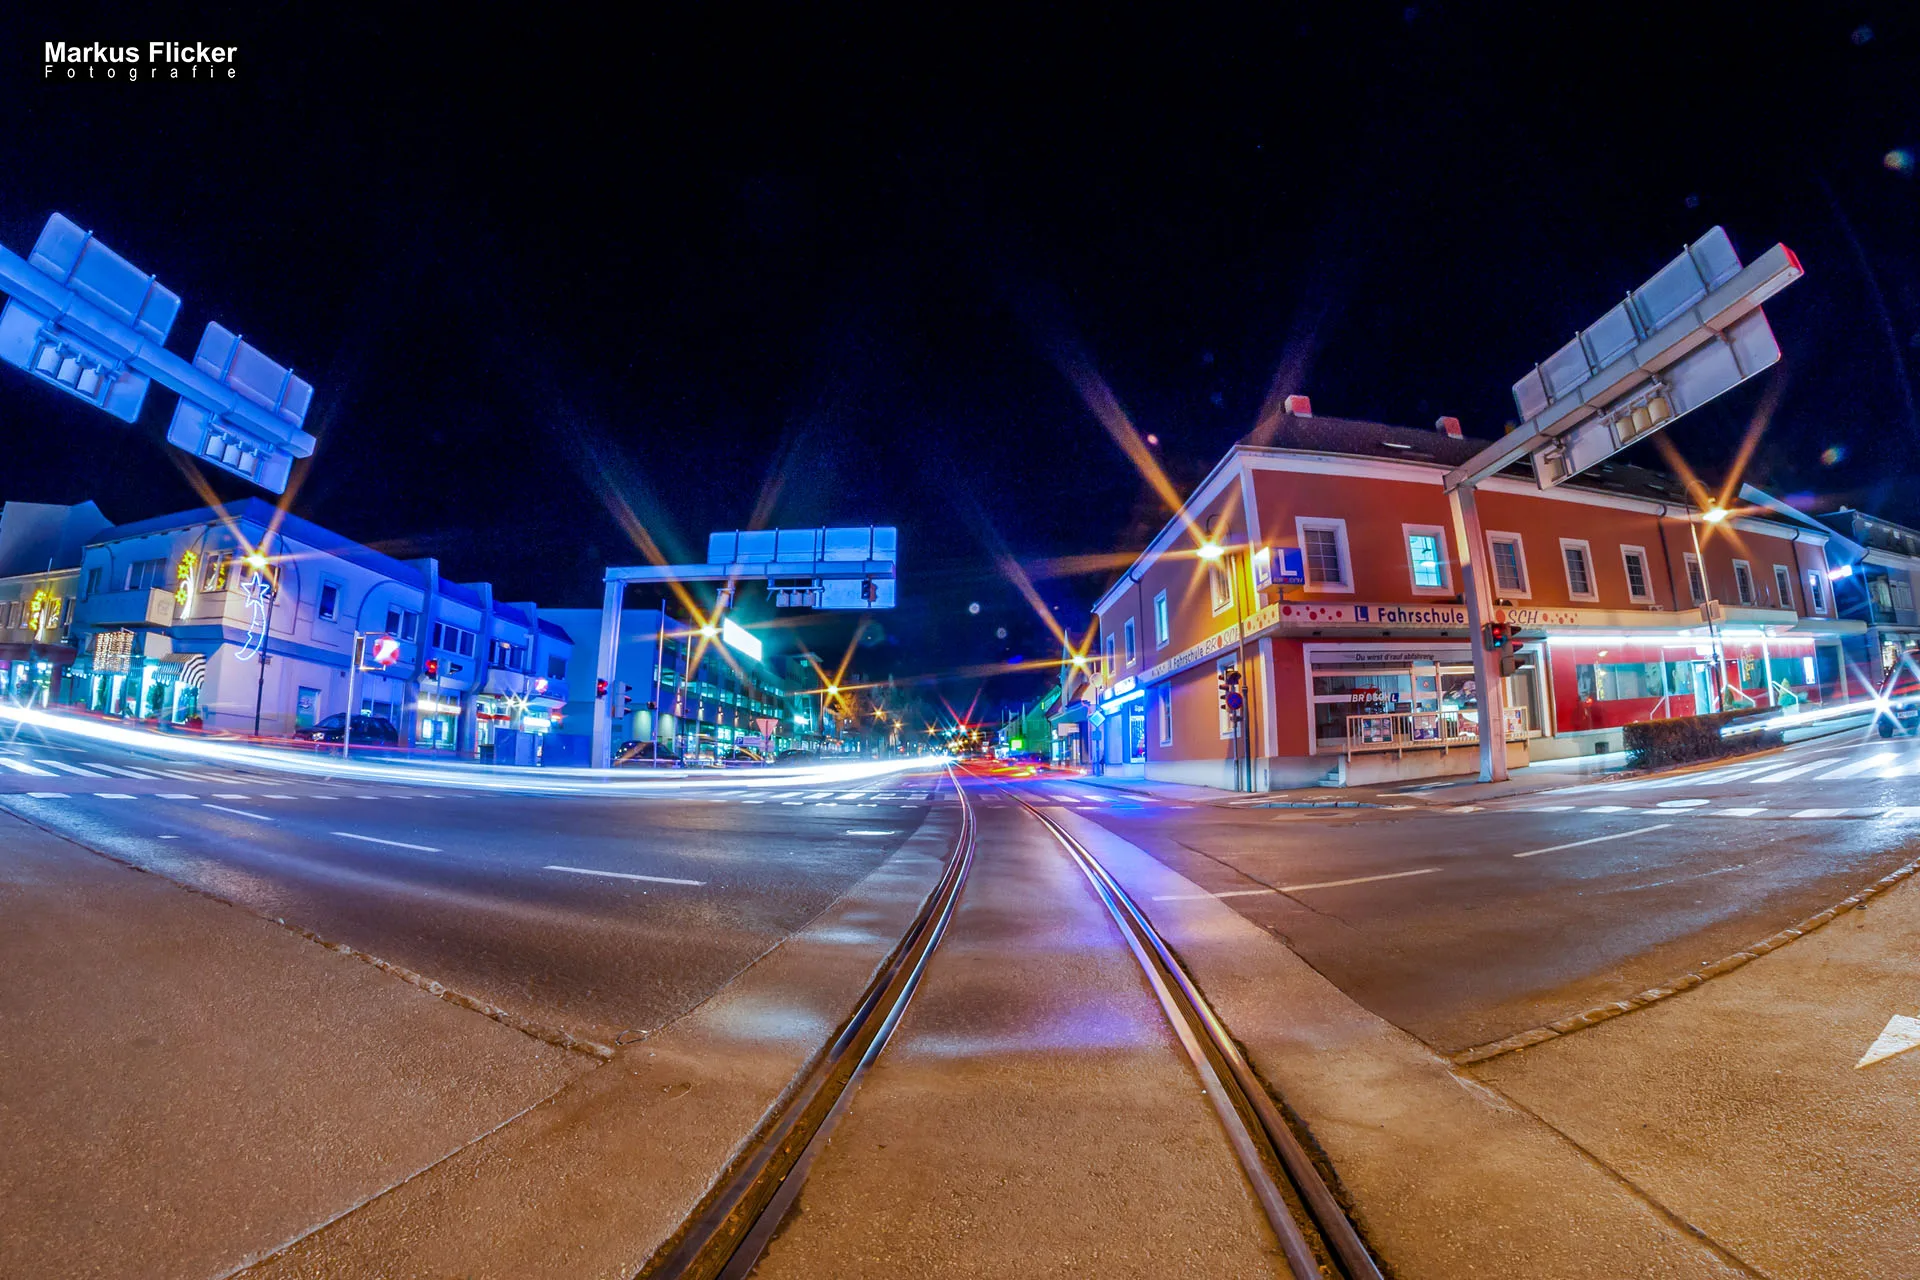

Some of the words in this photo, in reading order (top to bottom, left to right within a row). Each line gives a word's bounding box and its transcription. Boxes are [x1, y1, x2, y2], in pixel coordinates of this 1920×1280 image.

[1278, 549, 1298, 576] L
[1356, 606, 1368, 621] L
[1378, 605, 1465, 623] Fahrschule
